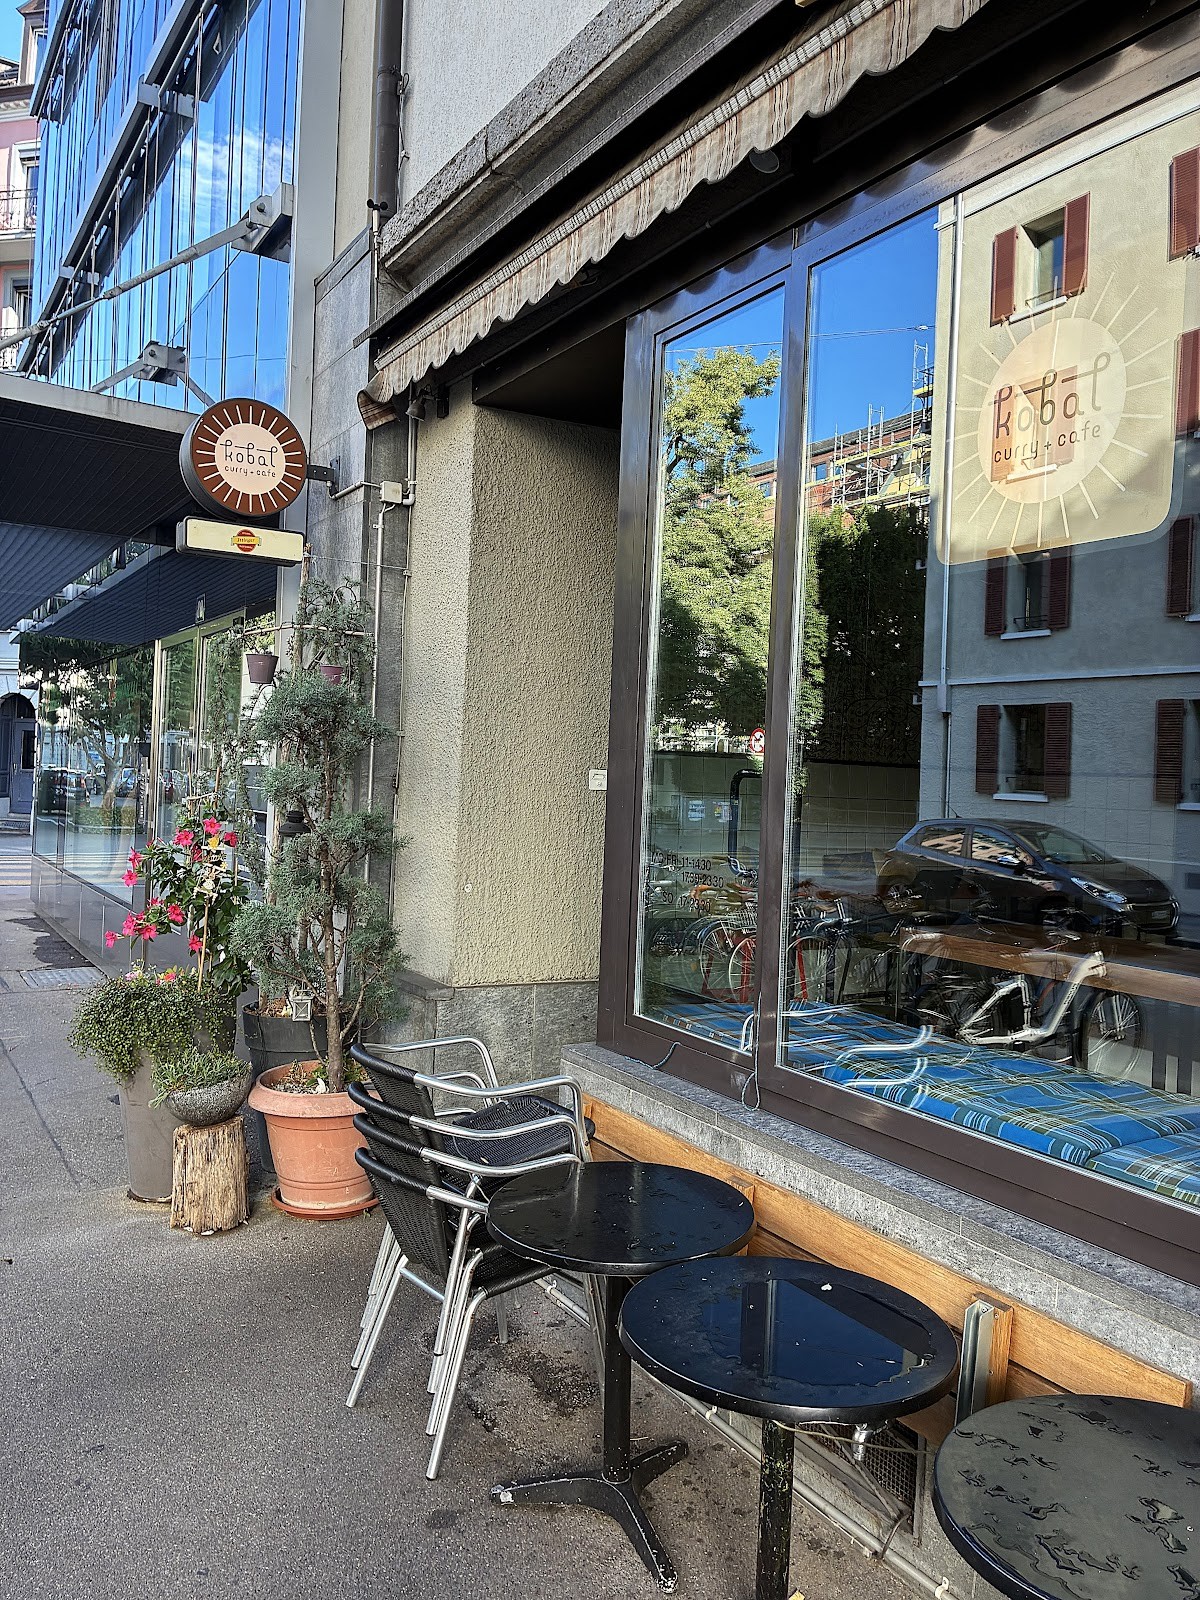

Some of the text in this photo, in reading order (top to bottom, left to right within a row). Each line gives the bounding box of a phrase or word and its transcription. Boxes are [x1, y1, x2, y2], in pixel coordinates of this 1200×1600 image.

[988, 351, 1111, 439] kobal
[219, 439, 279, 468] kobal
[994, 440, 1039, 463] curry
[1057, 420, 1101, 447] cafe
[224, 465, 248, 476] curry
[256, 468, 276, 478] cafe
